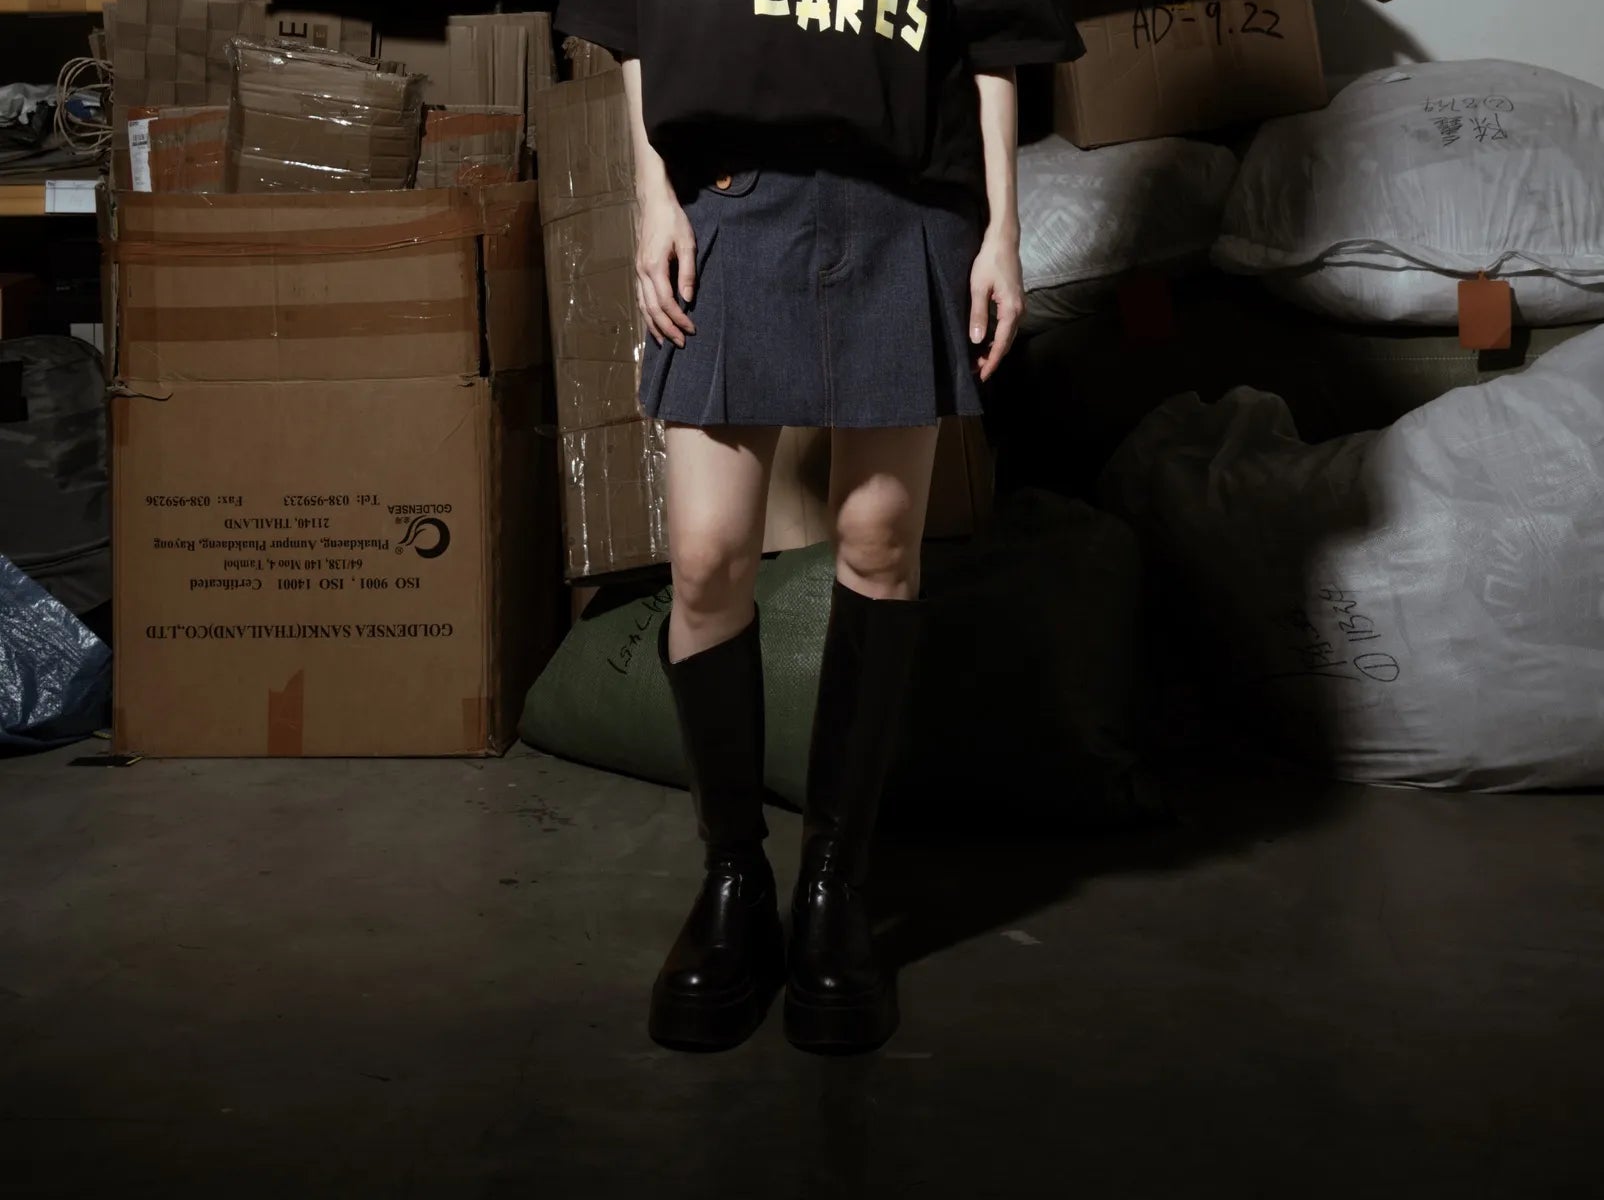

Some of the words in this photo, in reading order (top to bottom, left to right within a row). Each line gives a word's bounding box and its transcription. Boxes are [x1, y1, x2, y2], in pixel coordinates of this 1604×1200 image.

[146, 495, 210, 507] 038-959236
[217, 495, 242, 507] Fax:
[283, 495, 349, 506] 038-959233
[356, 494, 380, 506] Tel:
[387, 504, 452, 515] GOLDENSEA
[224, 518, 292, 529] THAILAND
[153, 538, 195, 551] Rayong
[198, 538, 266, 551] Pluakdaeng,
[270, 538, 316, 551] Aumpur
[319, 538, 389, 551] Pluakdaeng,
[224, 559, 263, 571] Tambol
[278, 559, 301, 570] Moo
[303, 559, 322, 570] 140
[190, 578, 262, 591] Certificated
[277, 578, 311, 590] 14001
[319, 577, 344, 590] ISO
[395, 577, 420, 589] ISO
[356, 623, 453, 638] GOLDENSEA
